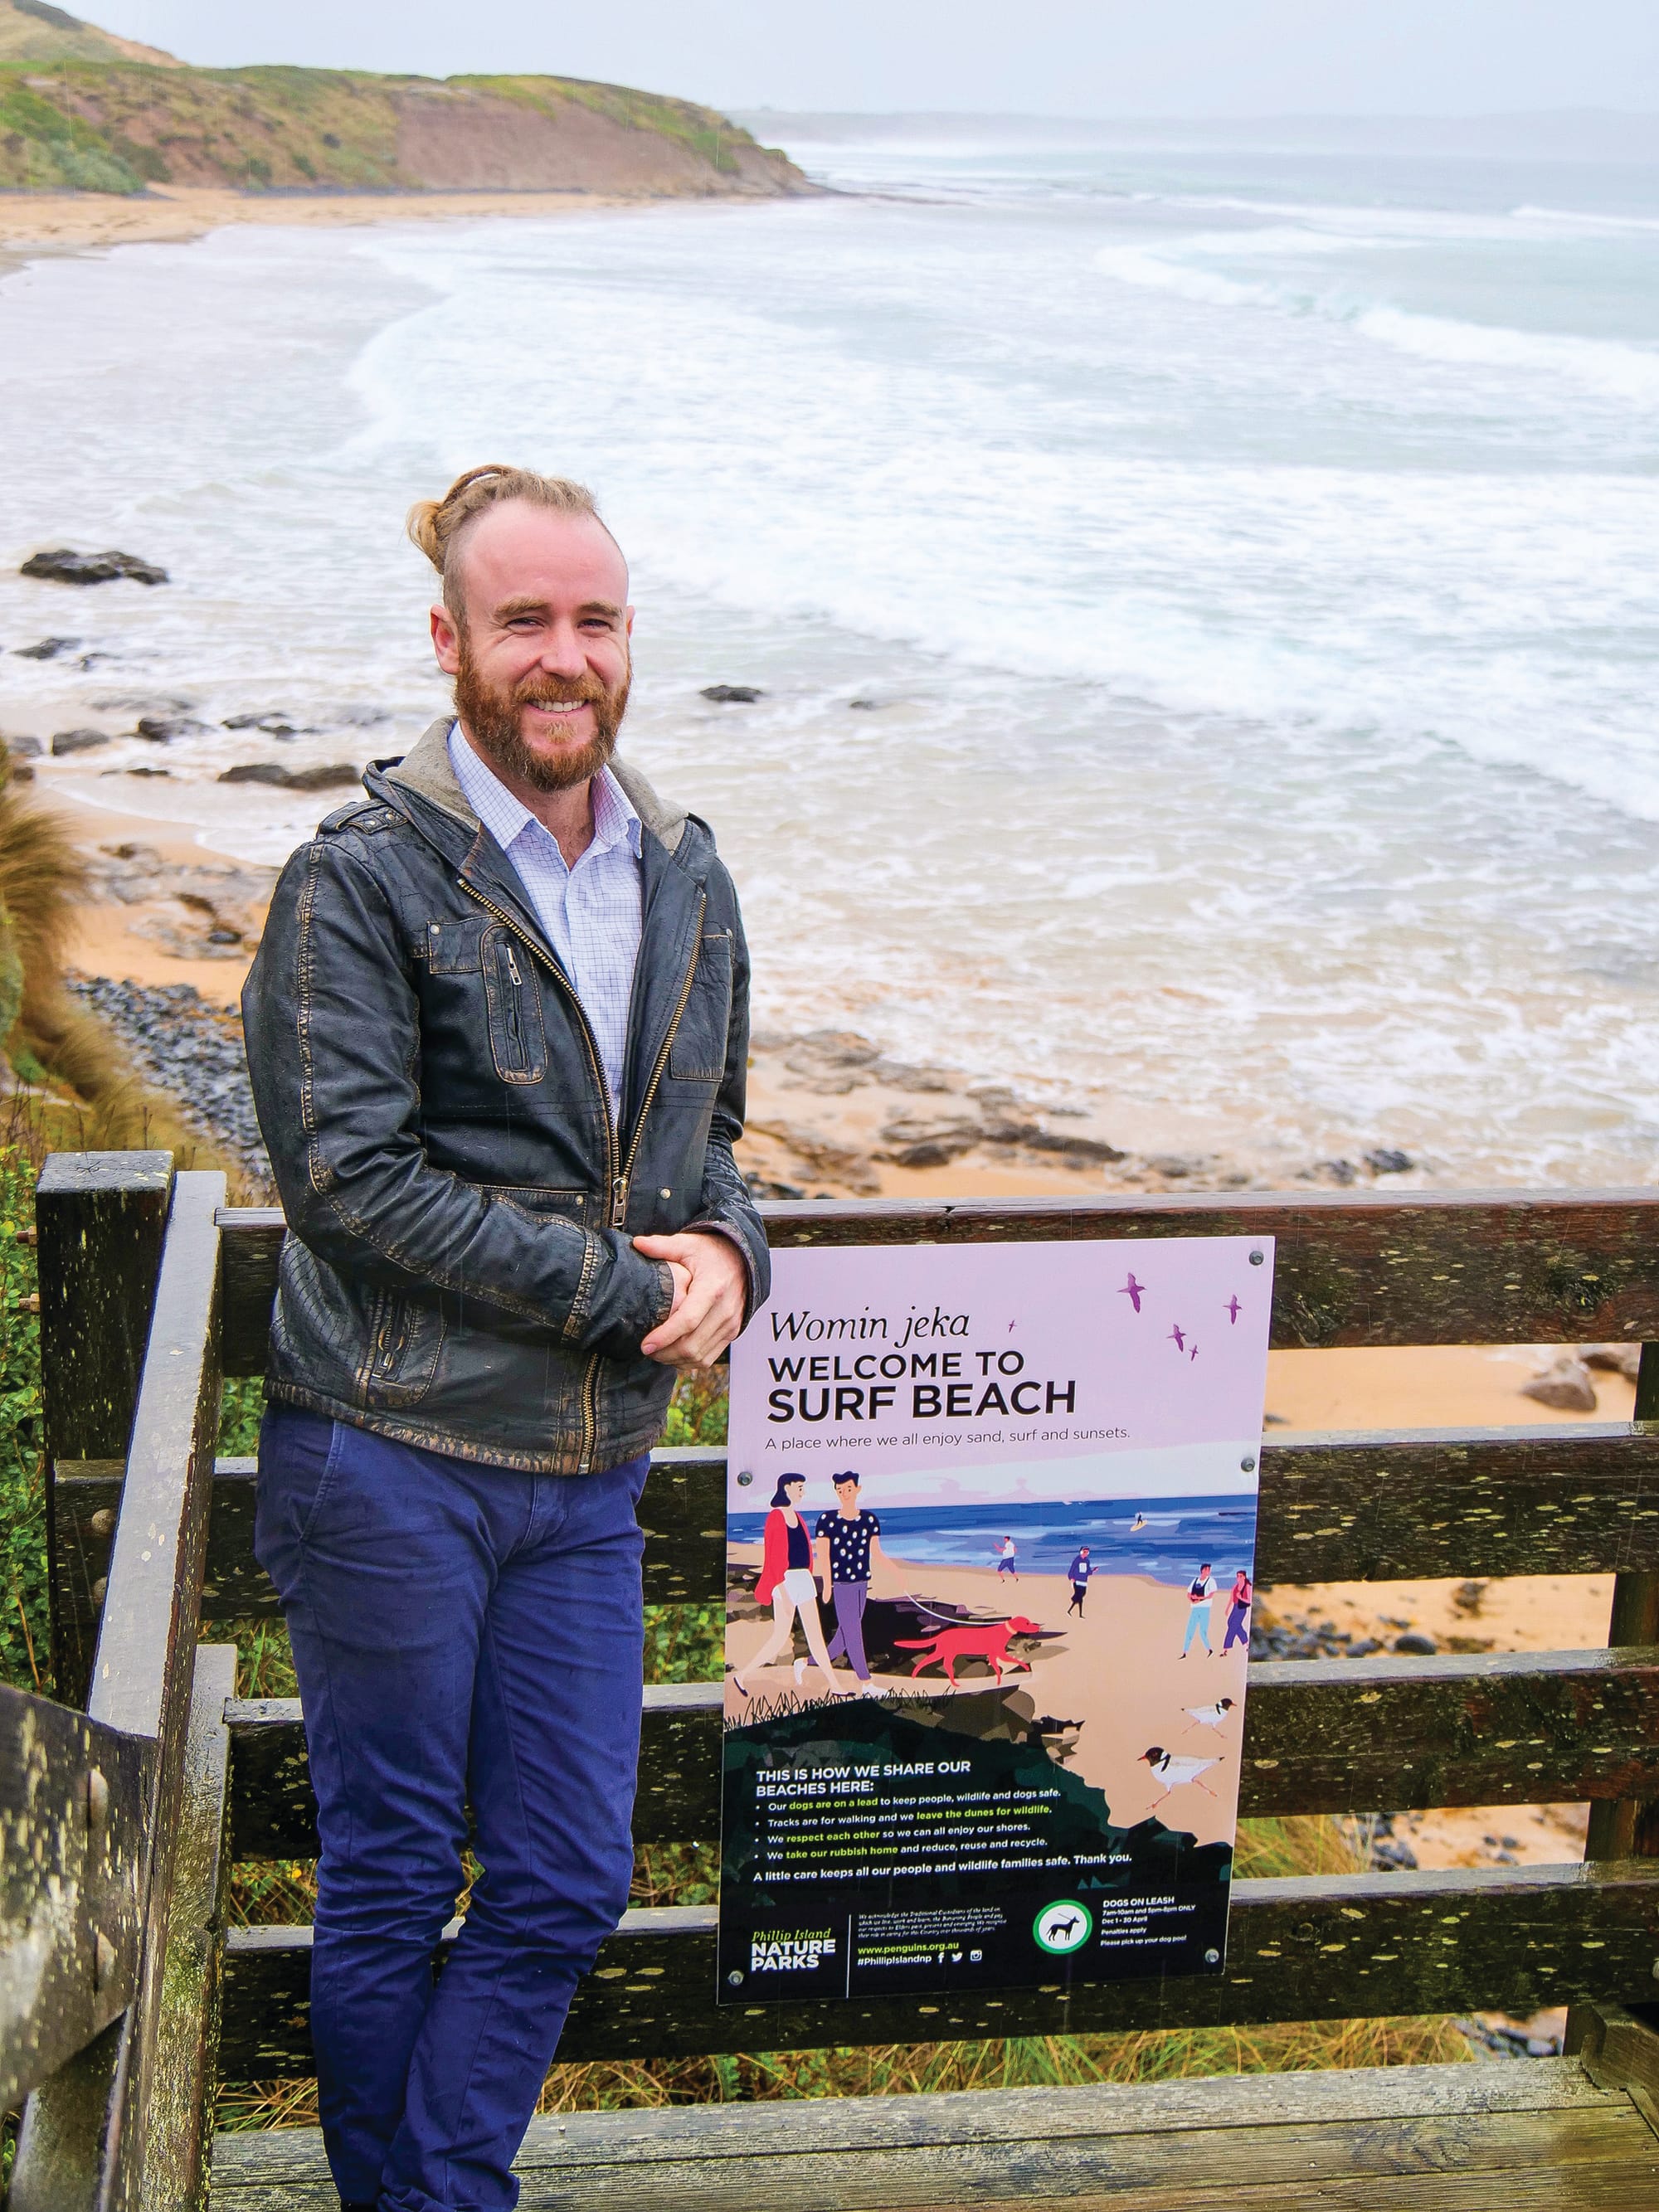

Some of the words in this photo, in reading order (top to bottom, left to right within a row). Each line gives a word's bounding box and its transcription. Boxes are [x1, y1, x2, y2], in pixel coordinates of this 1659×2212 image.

[771, 1306, 888, 1342] Womin
[893, 1305, 970, 1349] jeka
[767, 1352, 962, 1383] WELCOME
[975, 1350, 1025, 1377] TO
[767, 1385, 897, 1422] SURF
[912, 1380, 1076, 1417] BEACH
[764, 1437, 777, 1450] A
[781, 1437, 822, 1452] place
[825, 1435, 873, 1448] where
[876, 1437, 898, 1446] we
[902, 1432, 918, 1446] all
[922, 1432, 962, 1447] enjoy
[966, 1430, 1005, 1444] sand,
[1010, 1428, 1038, 1442] surf
[1041, 1427, 1068, 1441] and
[1073, 1427, 1130, 1440] sunsets.
[756, 1769, 791, 1782] THIS
[794, 1768, 809, 1782] IS
[810, 1766, 851, 1780] HOW
[854, 1764, 881, 1778] WE
[883, 1762, 935, 1777] SHARE
[937, 1760, 971, 1774] OUR
[756, 1782, 827, 1797] BEACHES
[830, 1780, 874, 1794] HERE:
[767, 1802, 787, 1811] Our
[788, 1801, 815, 1811] dogs
[815, 1801, 832, 1809] are
[857, 1796, 879, 1806] lead
[879, 1797, 891, 1806] to
[892, 1796, 917, 1806] keep
[917, 1793, 955, 1806] people,
[956, 1791, 991, 1802] wildlife
[991, 1790, 1012, 1801] and
[1012, 1790, 1038, 1801] dogs
[1038, 1787, 1062, 1798] safe.
[767, 1818, 800, 1828] Tracks
[801, 1818, 819, 1826] are
[820, 1816, 836, 1826] for
[837, 1814, 877, 1825] walking
[878, 1812, 898, 1823] and
[899, 1813, 915, 1821] we
[916, 1811, 944, 1821] leave
[945, 1809, 962, 1819] the
[963, 1808, 995, 1818] dunes
[995, 1806, 1012, 1816] for
[1013, 1804, 1053, 1816] wildlife.
[766, 1835, 785, 1845] We
[786, 1833, 825, 1844] respect
[825, 1831, 851, 1841] each
[852, 1830, 881, 1840] other
[882, 1830, 895, 1839] so
[896, 1830, 912, 1838] we
[912, 1829, 932, 1837] can
[932, 1826, 946, 1836] all
[946, 1826, 975, 1836] enjoy
[976, 1826, 995, 1834] our
[995, 1823, 1031, 1833] shores.
[766, 1851, 784, 1860] We
[786, 1850, 808, 1860] take
[829, 1846, 868, 1857] rubbish
[869, 1846, 899, 1855] home
[900, 1844, 920, 1854] and
[921, 1843, 959, 1853] reduce,
[960, 1841, 988, 1850] reuse
[989, 1839, 1009, 1849] and
[1010, 1837, 1048, 1849] recycle.
[752, 1872, 763, 1882] A
[764, 1870, 791, 1882] little
[792, 1871, 818, 1880] care
[820, 1869, 854, 1879] keeps
[855, 1866, 869, 1877] all
[870, 1867, 892, 1876] our
[893, 1863, 932, 1877] people
[933, 1861, 956, 1873] and
[957, 1859, 999, 1872] wildlife
[1000, 1857, 1044, 1869] families
[1044, 1855, 1072, 1867] safe.
[1073, 1853, 1107, 1865] Thank
[1108, 1854, 1133, 1865] you.
[1102, 1899, 1129, 1908] DOGS
[1130, 1898, 1145, 1907] ON
[1146, 1896, 1175, 1906] LEASH
[1132, 1915, 1148, 1923] April
[752, 1930, 791, 1944] Phillip
[793, 1928, 832, 1939] Island
[752, 1938, 836, 1957] NATURE
[858, 1942, 959, 1955] www.penguins.org.au
[751, 1954, 820, 1971] PARKS
